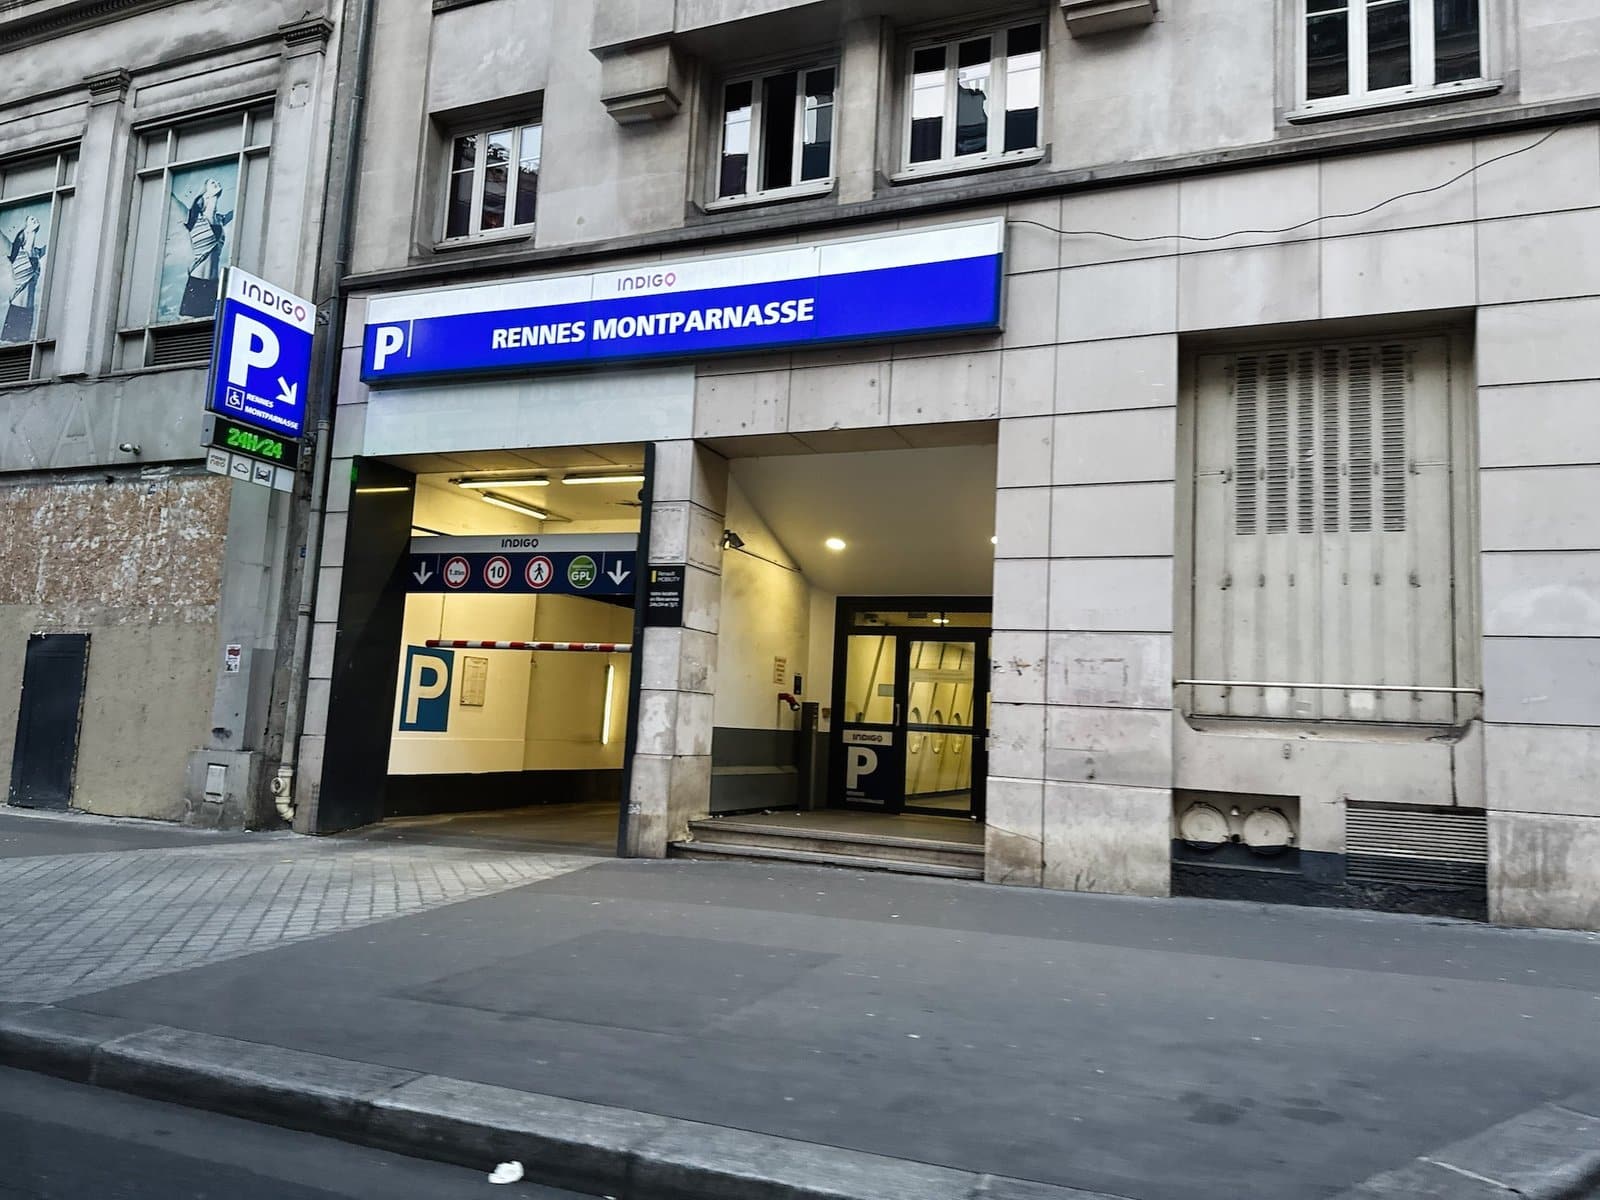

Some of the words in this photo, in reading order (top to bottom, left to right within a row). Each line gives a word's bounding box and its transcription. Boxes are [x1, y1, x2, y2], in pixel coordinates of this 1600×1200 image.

[617, 272, 676, 291] INDIGO
[242, 280, 306, 322] INDIGO
[492, 321, 586, 349] RENNES
[592, 298, 815, 341] MONTPARNASSE
[228, 313, 280, 387] P
[373, 326, 404, 370] P
[246, 393, 274, 408] RENNES
[244, 405, 299, 430] MONTPARNASSE
[227, 428, 283, 459] 24H/24
[501, 538, 539, 548] INDIGO
[490, 566, 504, 579] 10
[571, 571, 592, 581] GPL
[405, 654, 448, 723] P
[852, 734, 883, 742] INDIGO
[846, 746, 878, 789] P
